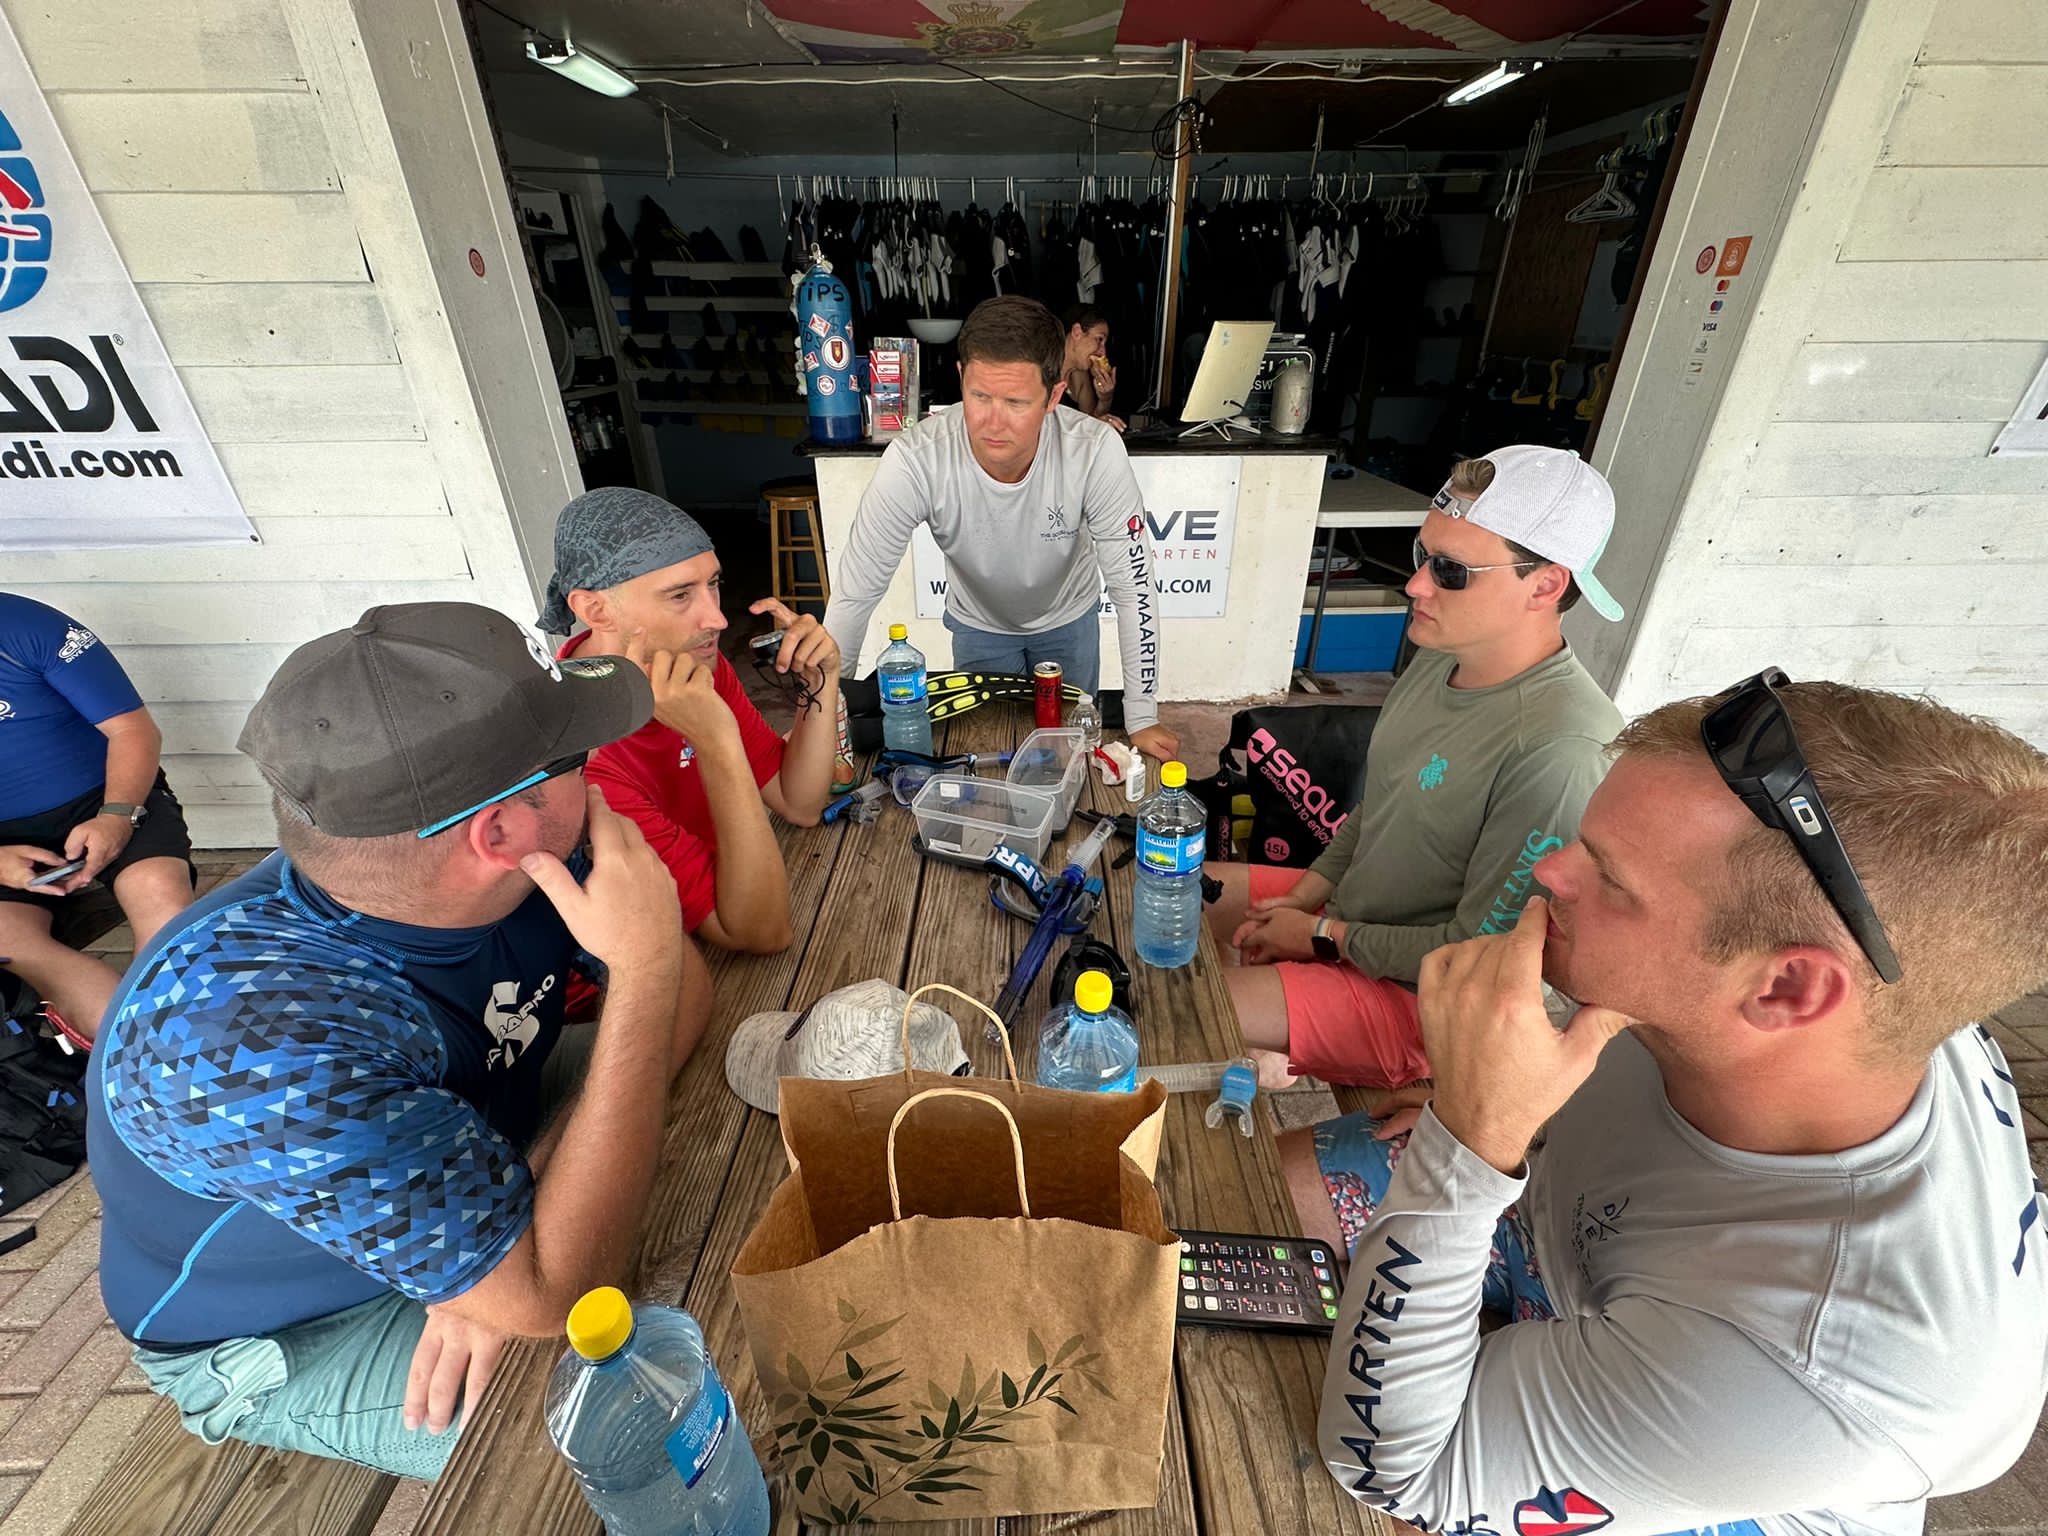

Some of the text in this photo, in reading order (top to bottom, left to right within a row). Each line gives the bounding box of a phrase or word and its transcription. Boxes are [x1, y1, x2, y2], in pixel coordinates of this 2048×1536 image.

[0, 440, 183, 479] di.com
[1129, 544, 1156, 694] SINT MAARTEN
[1259, 765, 1302, 811] designed
[1297, 808, 1310, 821] to
[1266, 842, 1287, 857] 15L
